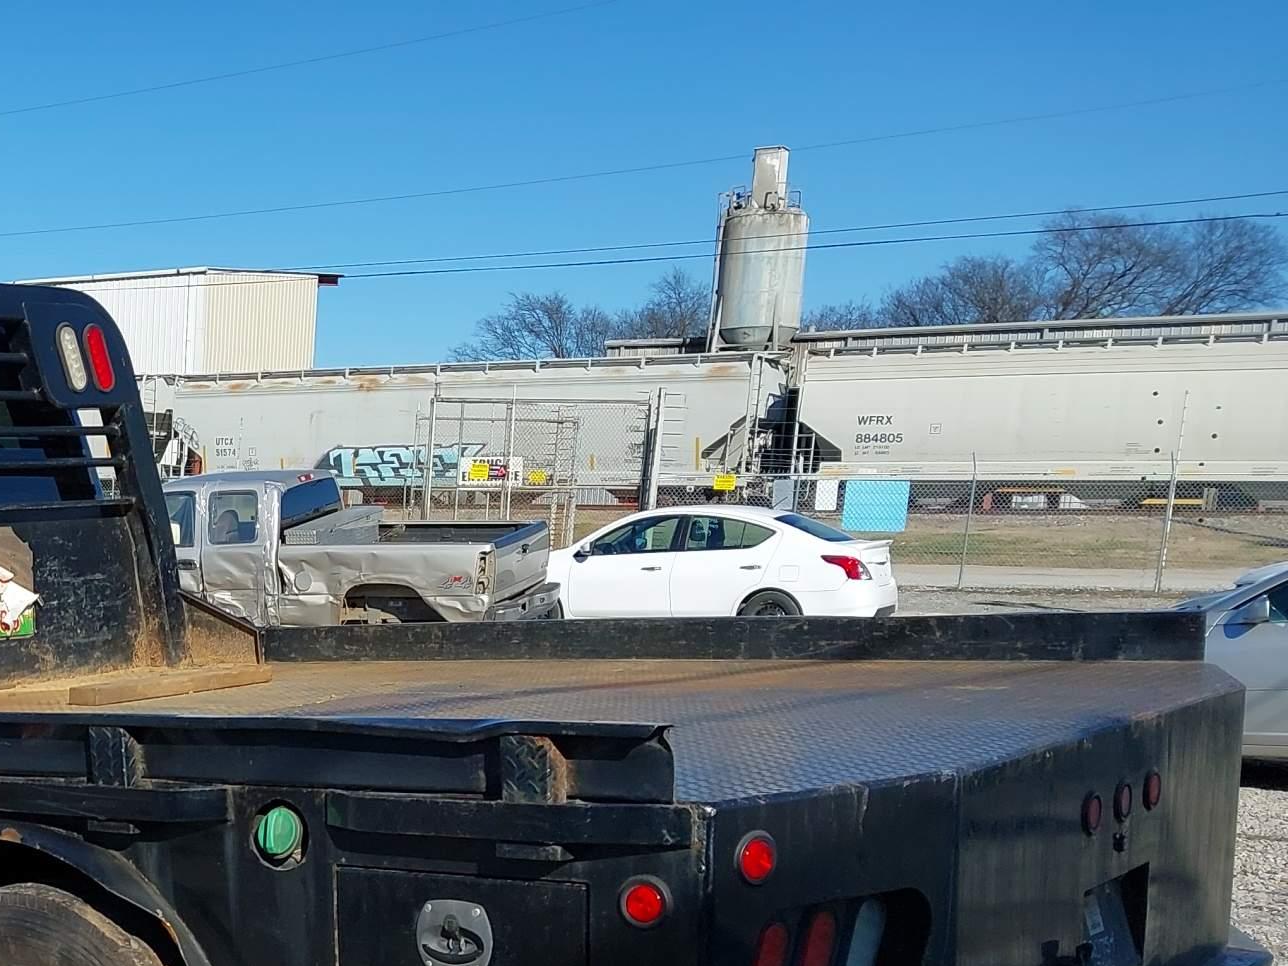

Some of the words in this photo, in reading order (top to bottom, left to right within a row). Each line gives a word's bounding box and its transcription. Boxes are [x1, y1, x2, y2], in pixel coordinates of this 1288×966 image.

[857, 415, 893, 426] WFRX
[215, 437, 234, 446] UTCX
[855, 433, 904, 444] 884805
[215, 448, 236, 457] 51574
